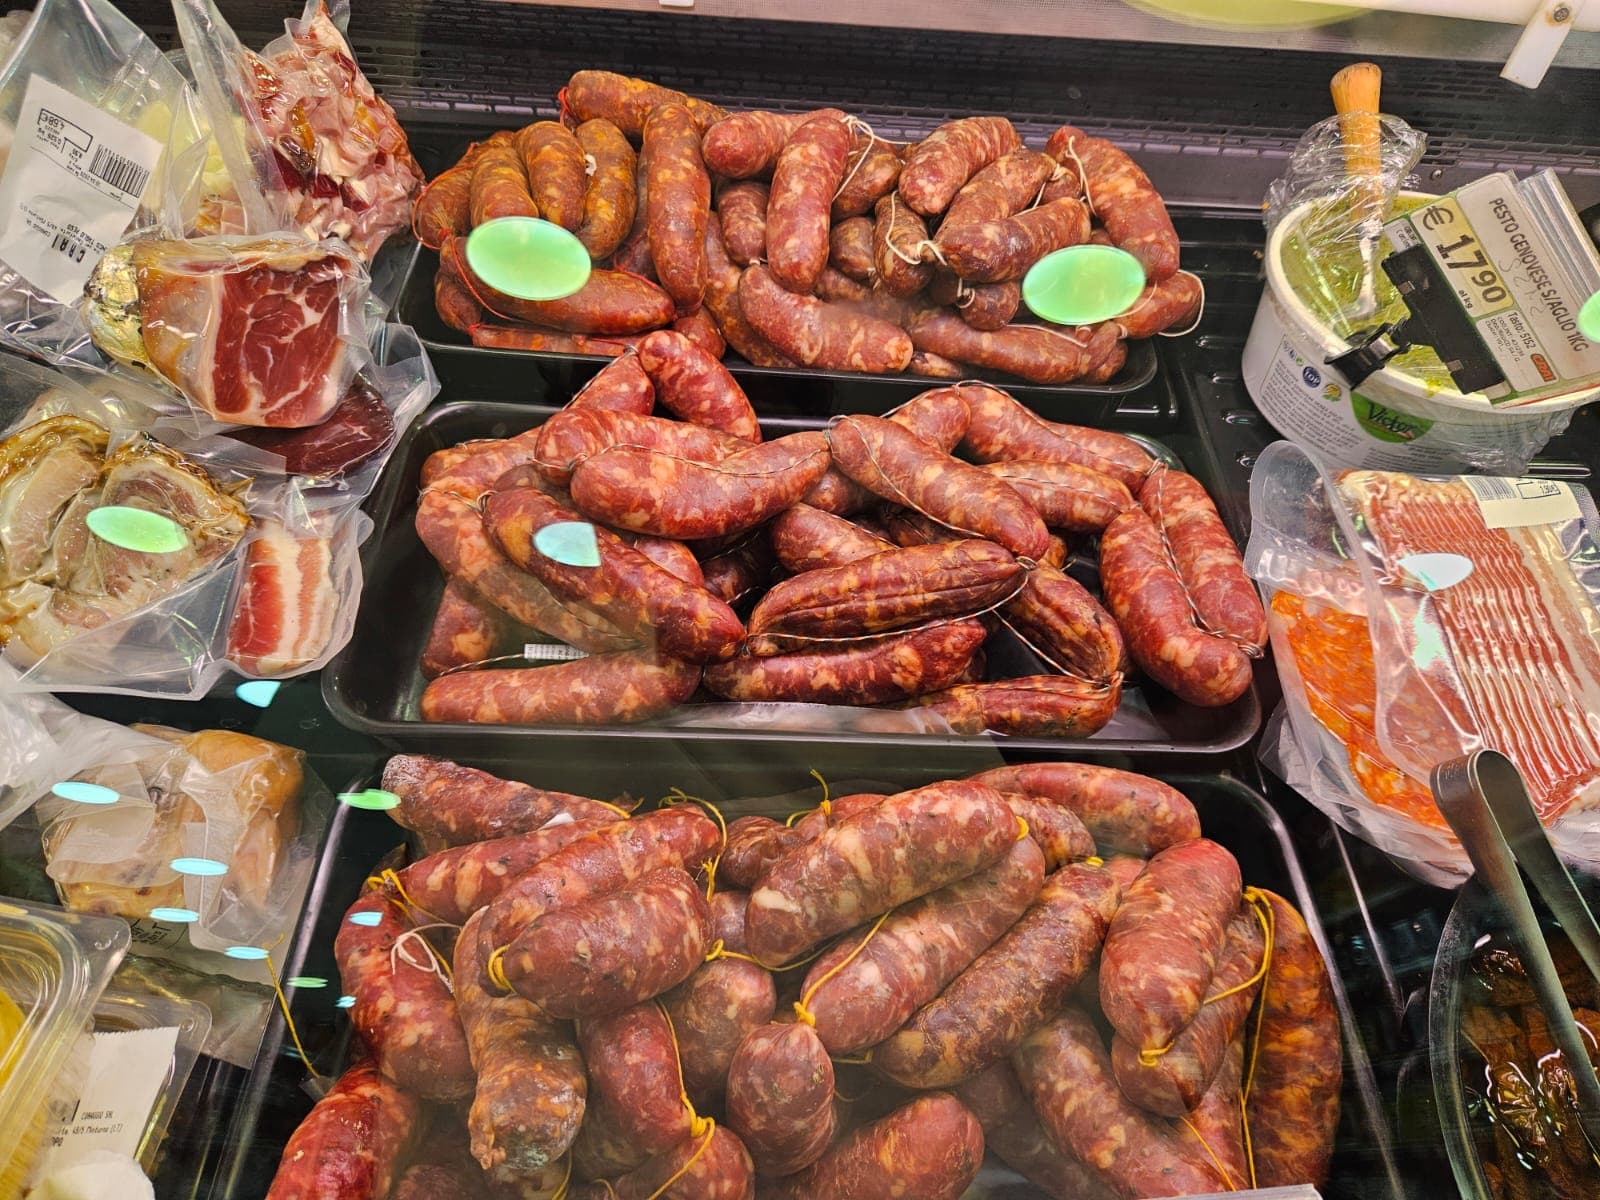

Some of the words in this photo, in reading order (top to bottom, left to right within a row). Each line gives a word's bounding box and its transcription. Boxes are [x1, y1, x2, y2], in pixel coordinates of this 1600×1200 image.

[1422, 205, 1454, 231] €
[51, 233, 86, 263] CRAI
[1489, 197, 1519, 233] PESTO
[1510, 233, 1552, 290] GENOVESE
[1541, 290, 1577, 332] S/AGLIO
[1567, 332, 1589, 352] 1KG
[1508, 312, 1523, 333] Tasto:
[1520, 332, 1536, 349] 5152
